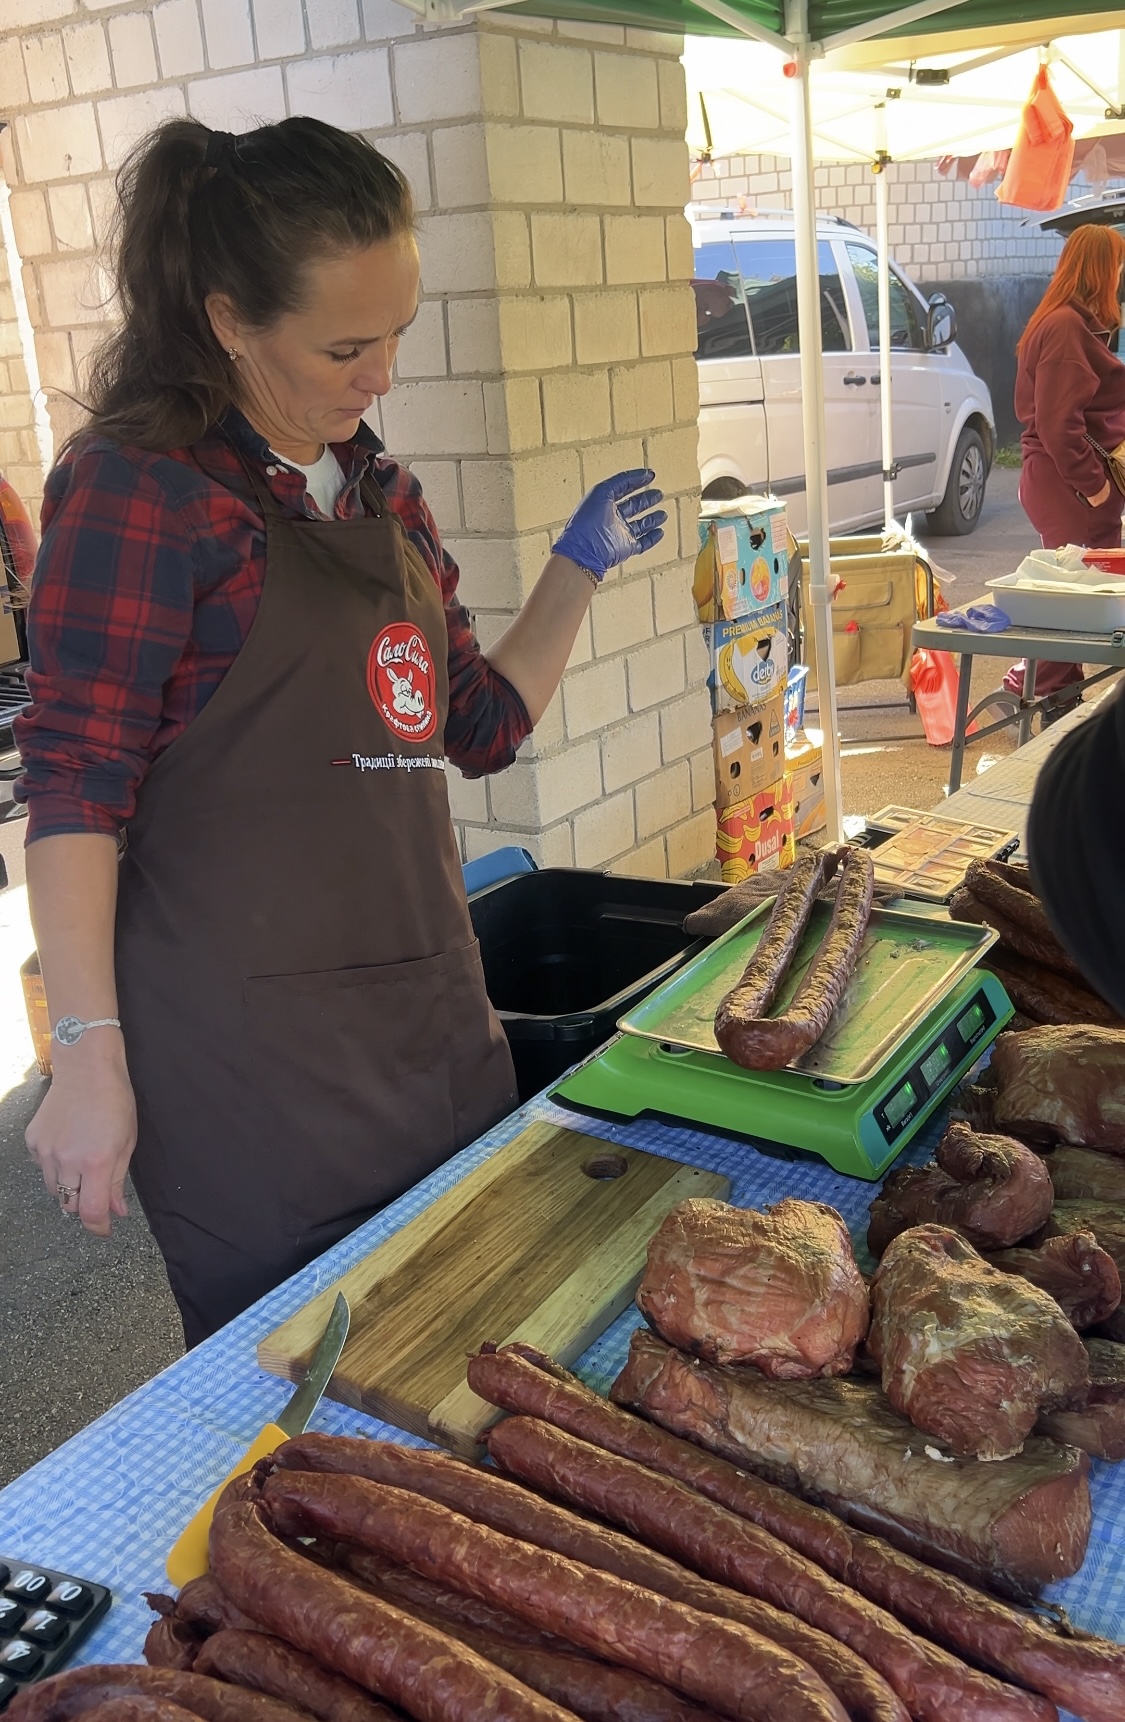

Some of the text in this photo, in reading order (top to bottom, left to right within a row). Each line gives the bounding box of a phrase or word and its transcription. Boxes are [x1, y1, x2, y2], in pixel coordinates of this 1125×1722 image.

[722, 618, 758, 638] PREMIUM
[352, 753, 395, 772] Традиції
[755, 829, 779, 861] Dusal
[14, 1572, 46, 1591] 00
